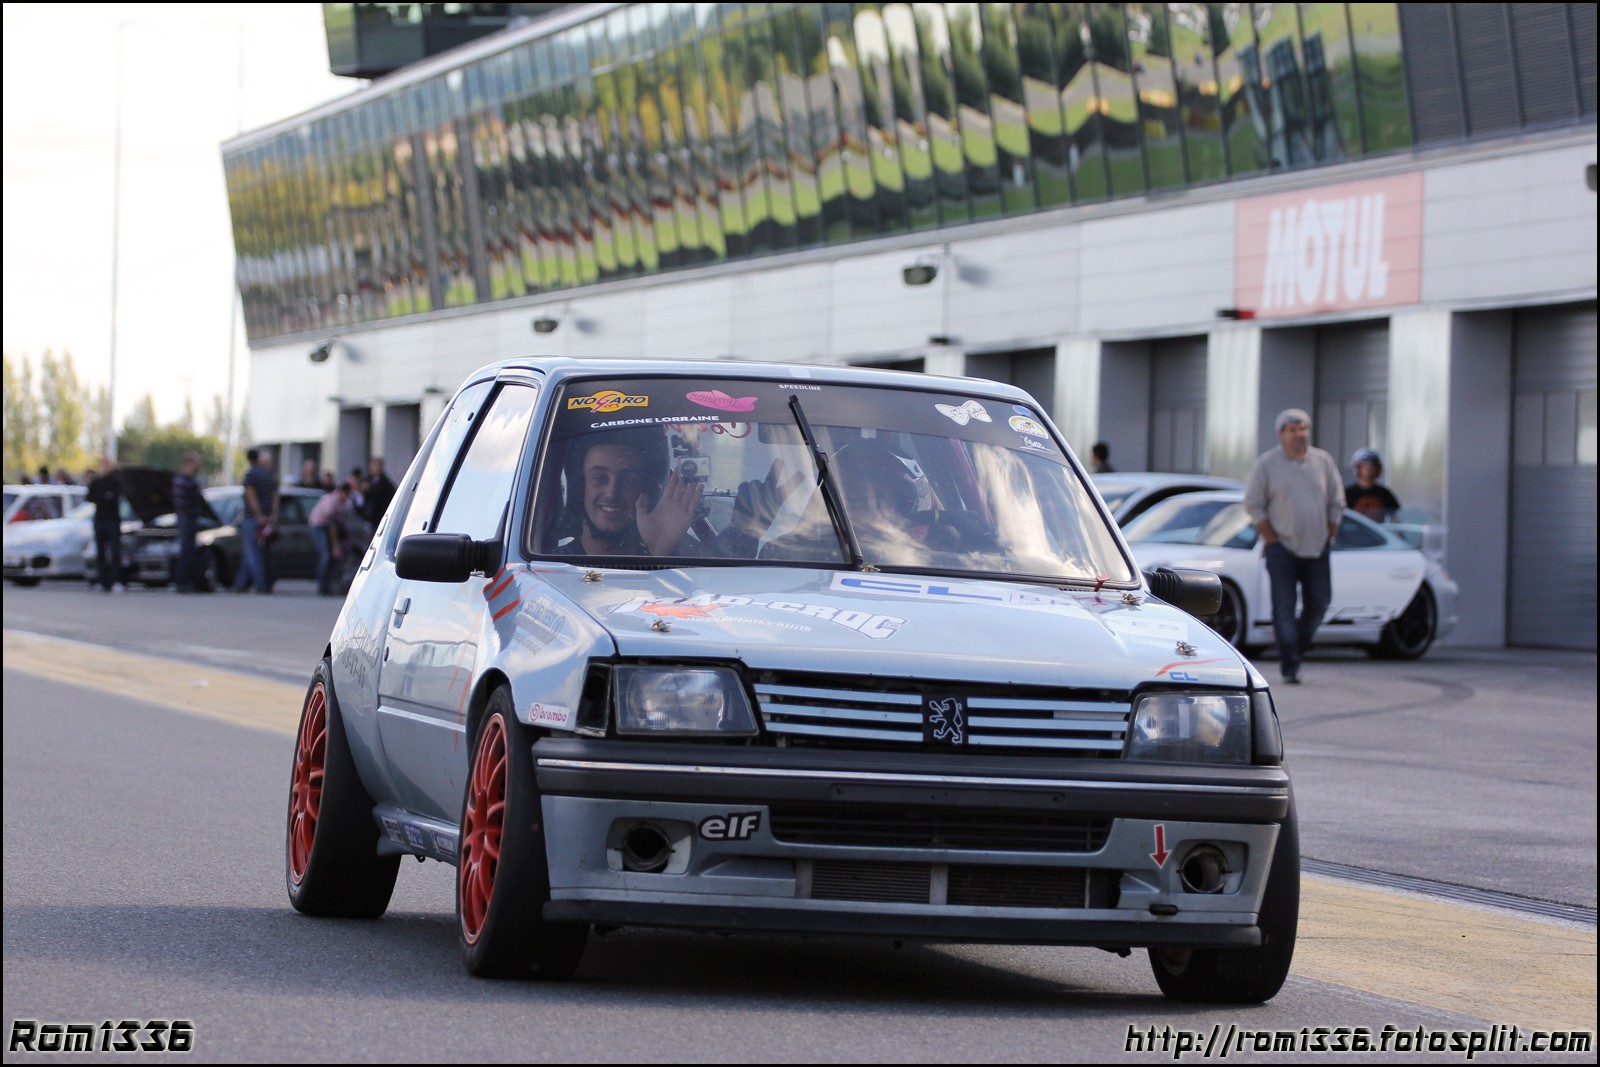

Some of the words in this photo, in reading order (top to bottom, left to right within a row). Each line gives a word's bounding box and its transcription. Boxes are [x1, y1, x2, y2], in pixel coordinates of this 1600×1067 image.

[1261, 192, 1388, 309] MOTUL
[570, 393, 647, 413] NOGARO
[590, 417, 653, 429] CARBONE
[655, 415, 720, 423] LORRAINE
[1169, 671, 1199, 682] CL
[540, 707, 567, 722] brembo
[701, 815, 757, 838] elf
